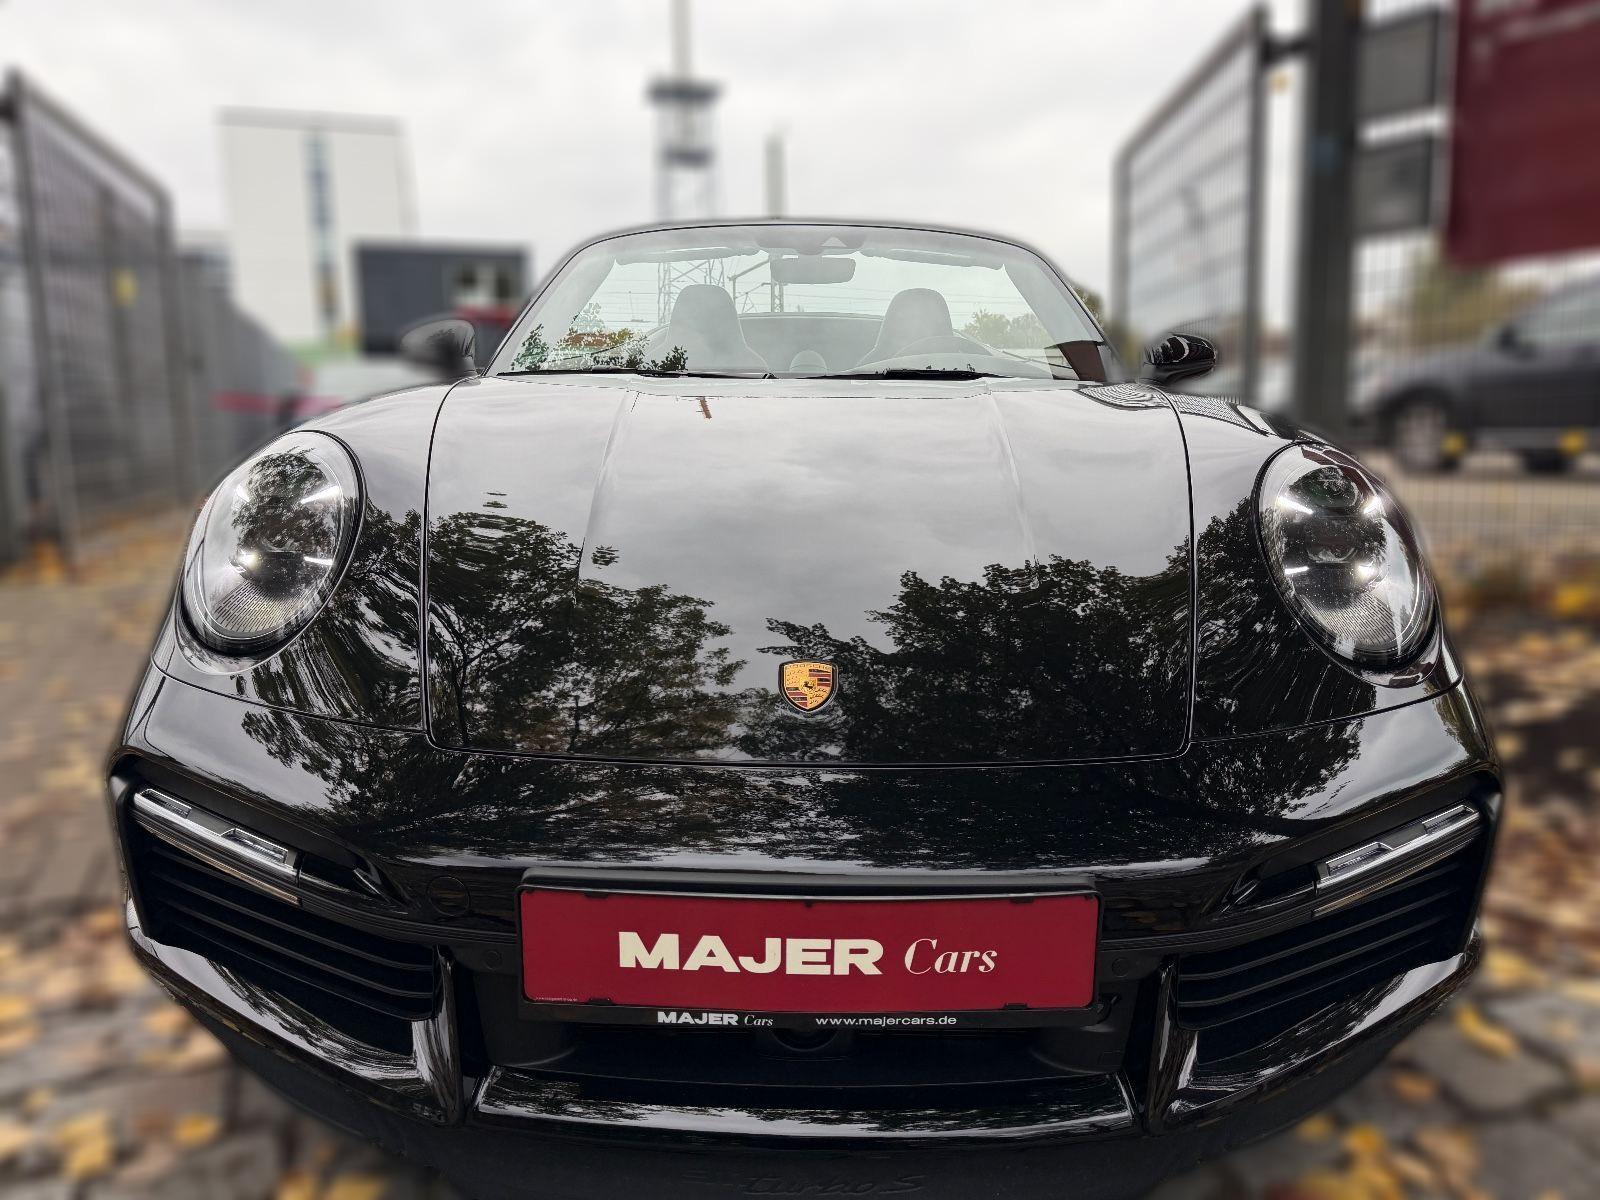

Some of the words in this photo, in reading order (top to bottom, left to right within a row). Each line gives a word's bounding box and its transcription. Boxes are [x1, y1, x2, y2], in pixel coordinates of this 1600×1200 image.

[618, 931, 884, 976] MAJER
[904, 938, 998, 975] Cars
[657, 1010, 739, 1026] MAJER
[743, 1011, 774, 1028] Cars
[815, 1014, 957, 1028] www.majercars.de
